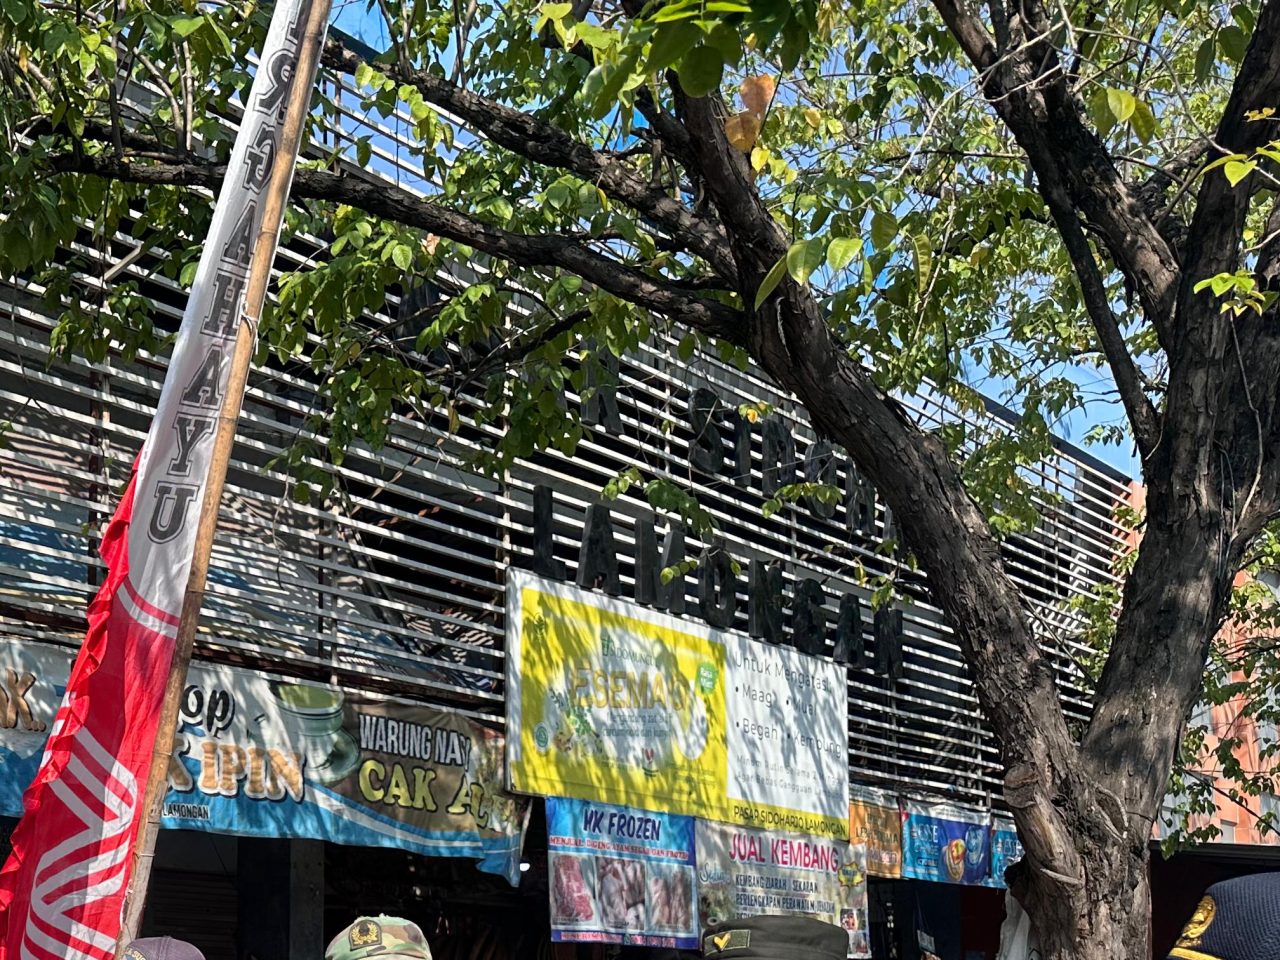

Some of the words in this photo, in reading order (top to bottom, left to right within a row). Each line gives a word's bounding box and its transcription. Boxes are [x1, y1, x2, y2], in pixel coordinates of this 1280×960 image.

[532, 485, 904, 679] LAMONGAN
[735, 651, 771, 676] Untuk
[179, 683, 235, 740] op
[741, 683, 774, 708] Maag
[358, 712, 432, 758] WARUNG
[742, 717, 778, 742] Begah
[197, 738, 306, 804] IPIN
[357, 758, 437, 813] CAK
[582, 808, 605, 835] HK
[607, 813, 662, 842] FROZEN
[733, 805, 760, 823] PASAR
[804, 815, 847, 836] LAMONGAN
[729, 833, 766, 863] JUAL
[771, 838, 839, 873] KEMBANG
[735, 873, 765, 889] KEMBANG
